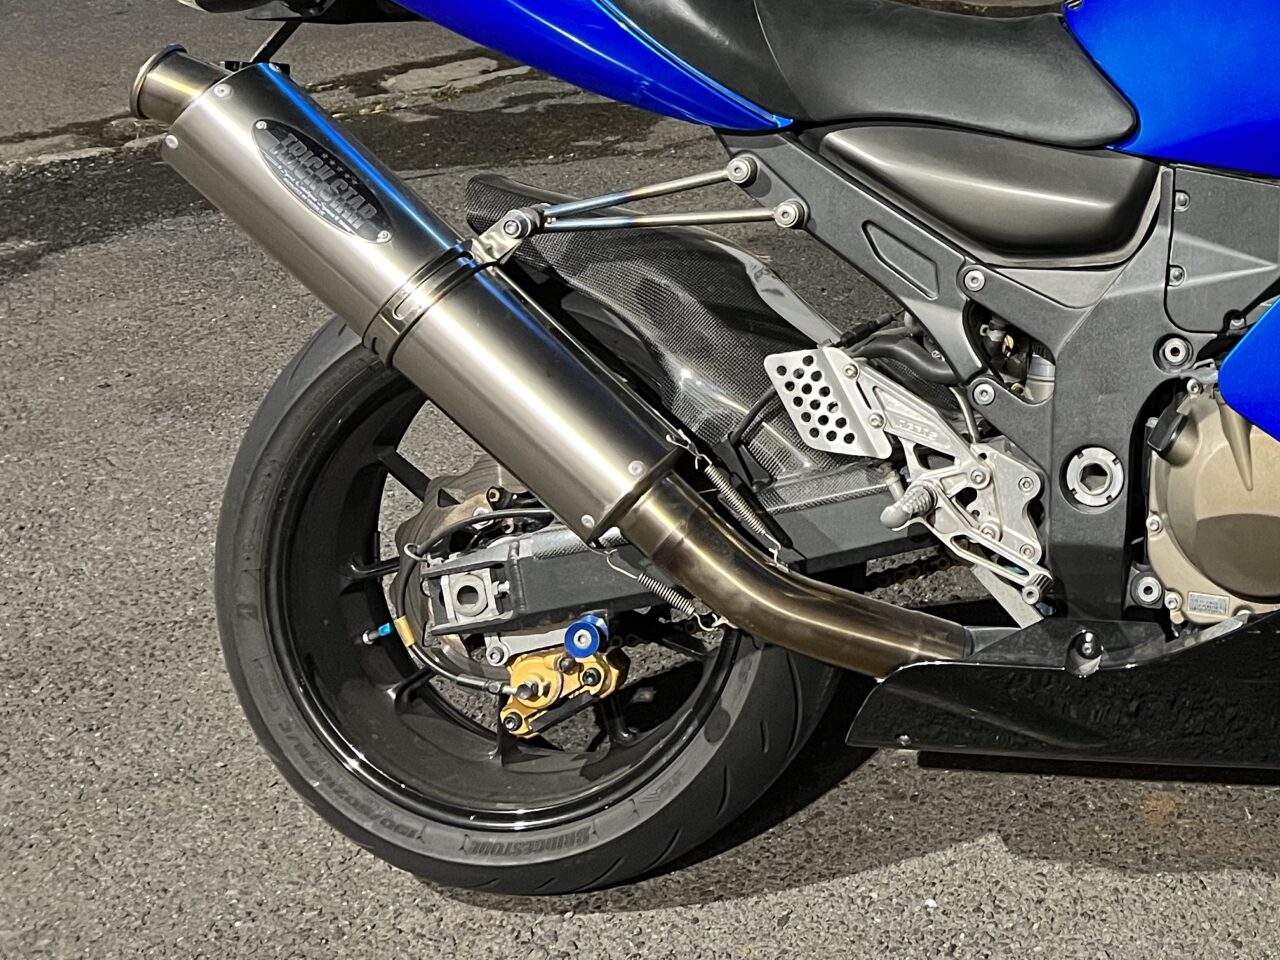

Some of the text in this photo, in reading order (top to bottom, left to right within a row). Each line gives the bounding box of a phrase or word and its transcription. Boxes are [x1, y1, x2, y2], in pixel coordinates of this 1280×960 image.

[270, 132, 336, 189] TRICK
[316, 177, 378, 229] STAR
[468, 826, 592, 857] BRIDGESTONE
